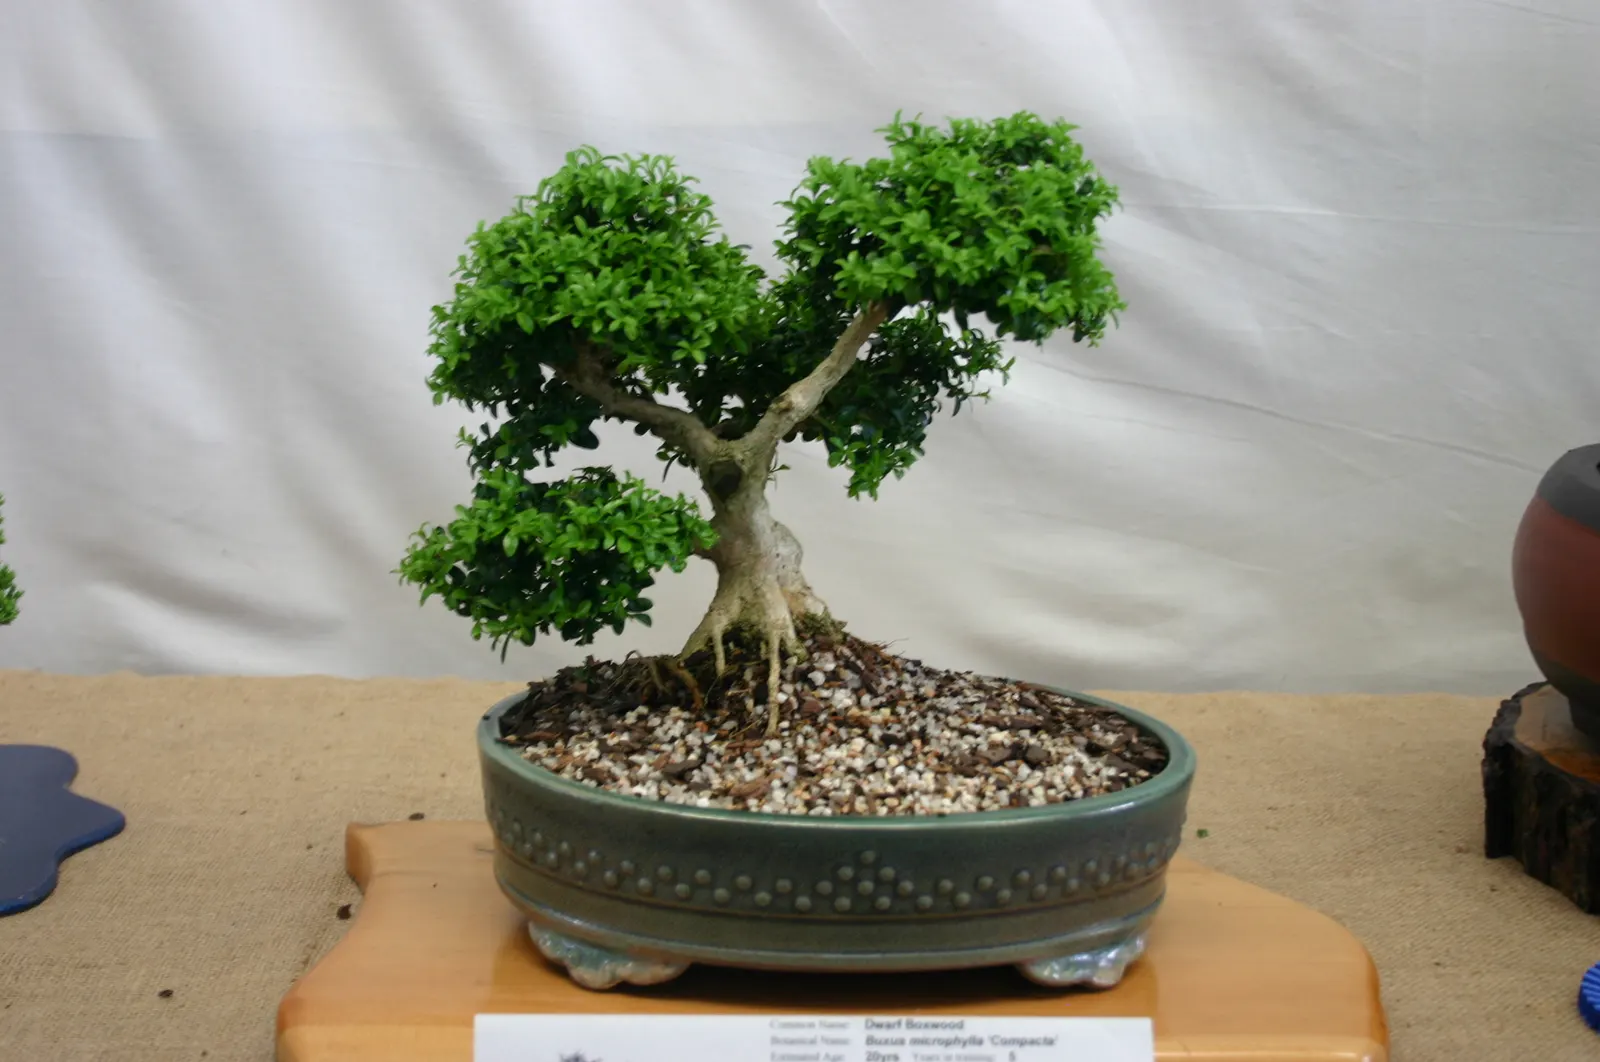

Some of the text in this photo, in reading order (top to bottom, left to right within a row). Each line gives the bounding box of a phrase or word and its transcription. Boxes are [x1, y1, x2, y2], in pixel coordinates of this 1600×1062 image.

[865, 1018, 902, 1029] Dwarf
[906, 1018, 964, 1029] Boxwood
[865, 1035, 905, 1046] Buxus
[909, 1035, 984, 1048] microphylla
[865, 1051, 900, 1062] 20yrs
